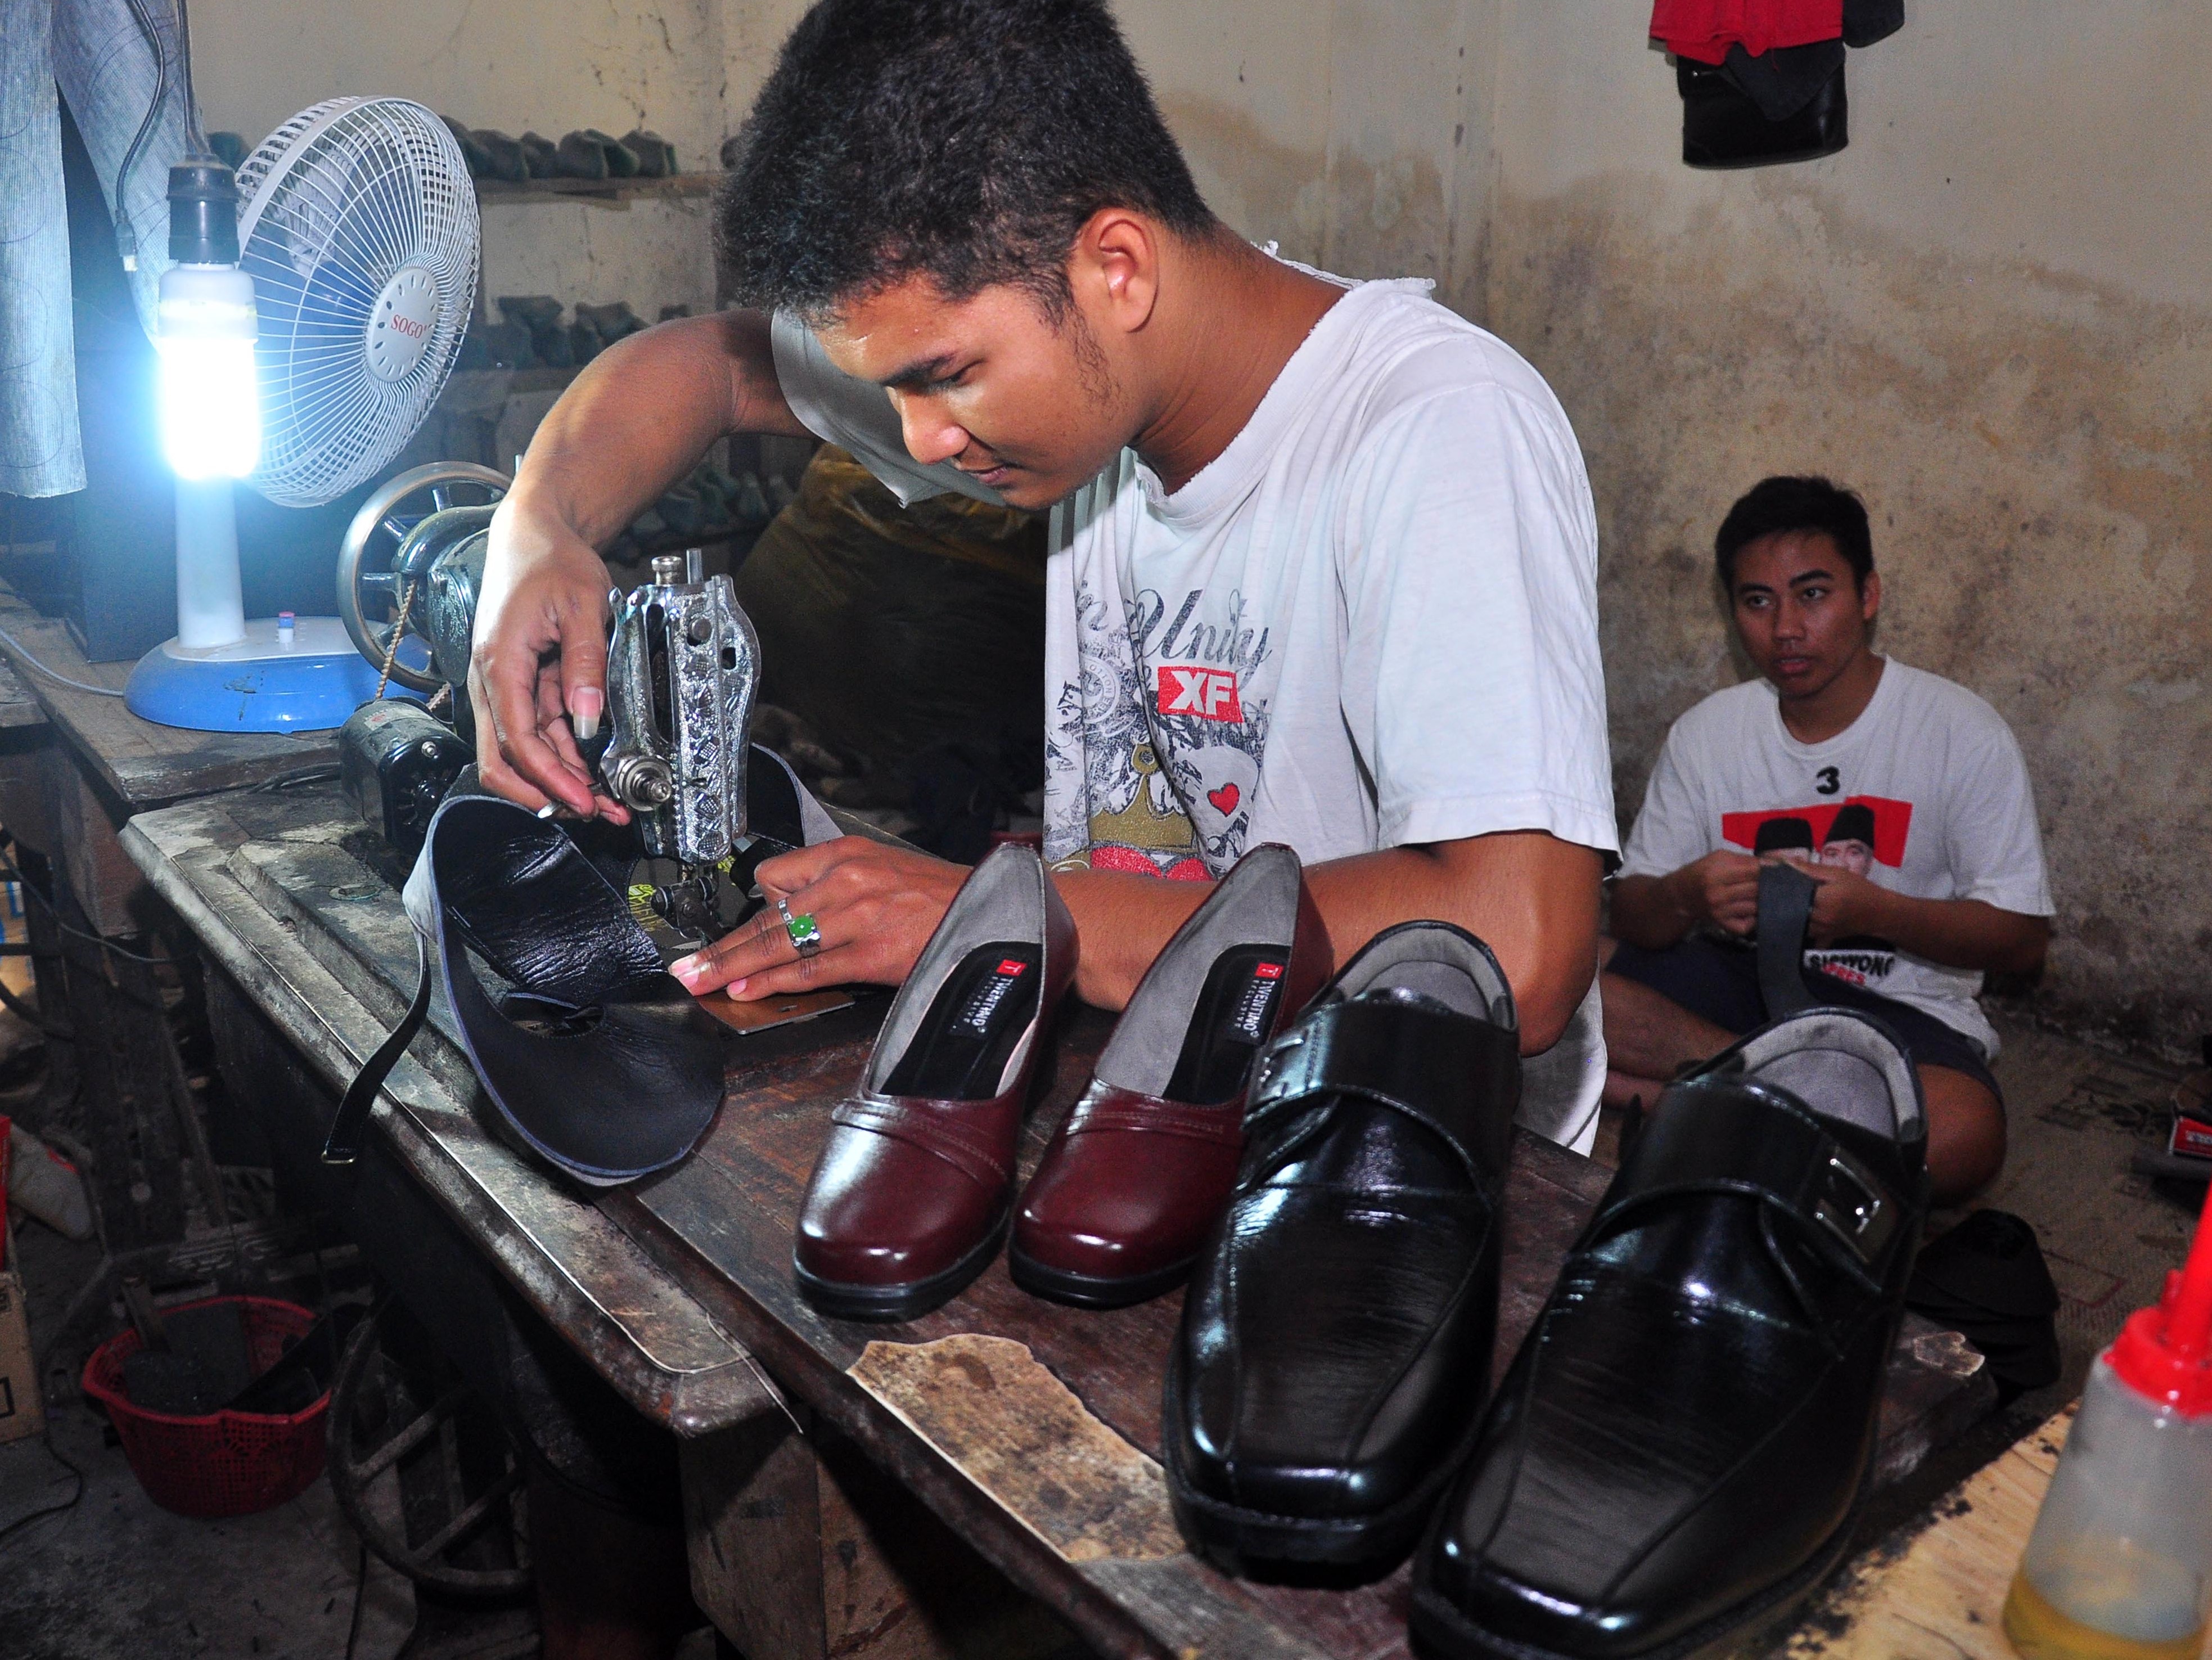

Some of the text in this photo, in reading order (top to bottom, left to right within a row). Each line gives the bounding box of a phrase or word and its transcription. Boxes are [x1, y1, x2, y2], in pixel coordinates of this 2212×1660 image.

[391, 314, 423, 339] SOGO
[1136, 588, 1272, 691] Unity
[1168, 669, 1233, 716] XF
[1816, 766, 1840, 795] 3
